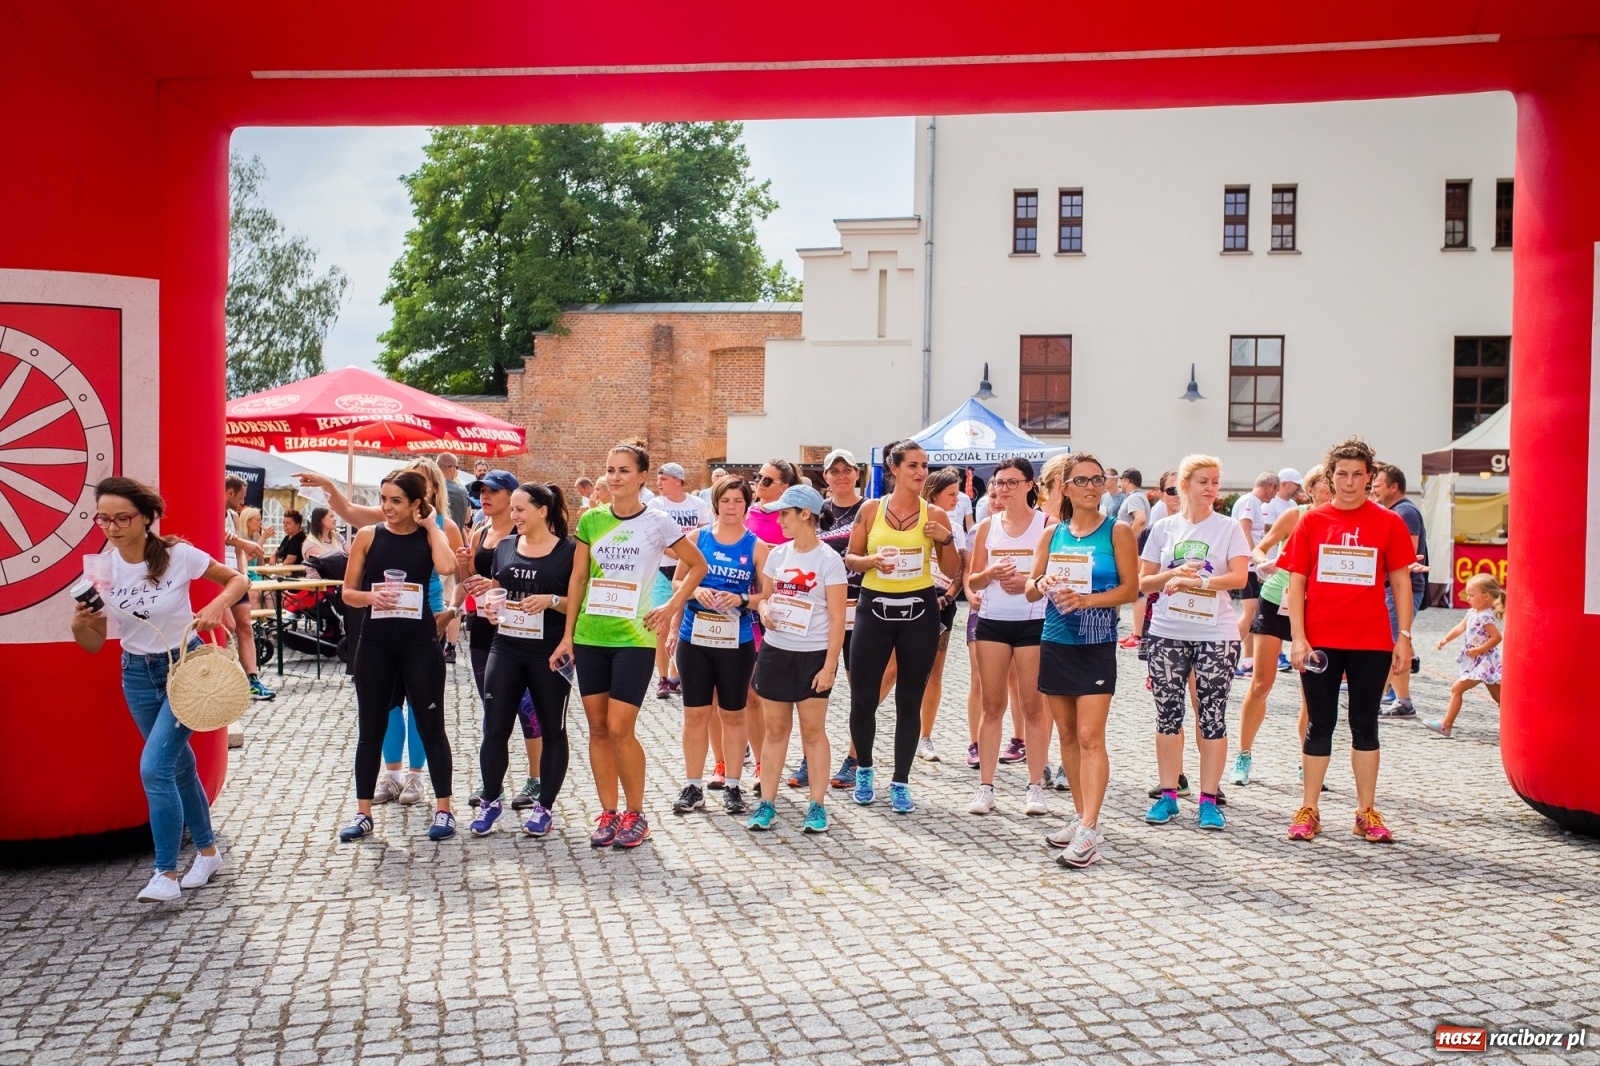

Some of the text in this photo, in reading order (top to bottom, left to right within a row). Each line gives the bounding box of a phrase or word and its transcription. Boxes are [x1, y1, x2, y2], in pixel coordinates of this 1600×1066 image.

[226, 419, 292, 435] IBORSKIE
[316, 413, 432, 431] RACIBORSKIE
[934, 452, 982, 462] ODDZIAŁ
[1491, 454, 1510, 473] g
[667, 509, 698, 517] OUSE
[671, 515, 698, 527] AND
[597, 546, 640, 555] AKTYWNI
[1340, 560, 1355, 571] 53
[513, 568, 537, 580] STAY
[707, 563, 751, 580] NNERS
[1058, 566, 1071, 577] 28
[604, 592, 618, 602] 30
[1187, 599, 1195, 608] 8
[513, 614, 525, 625] 29
[709, 625, 722, 635] 40
